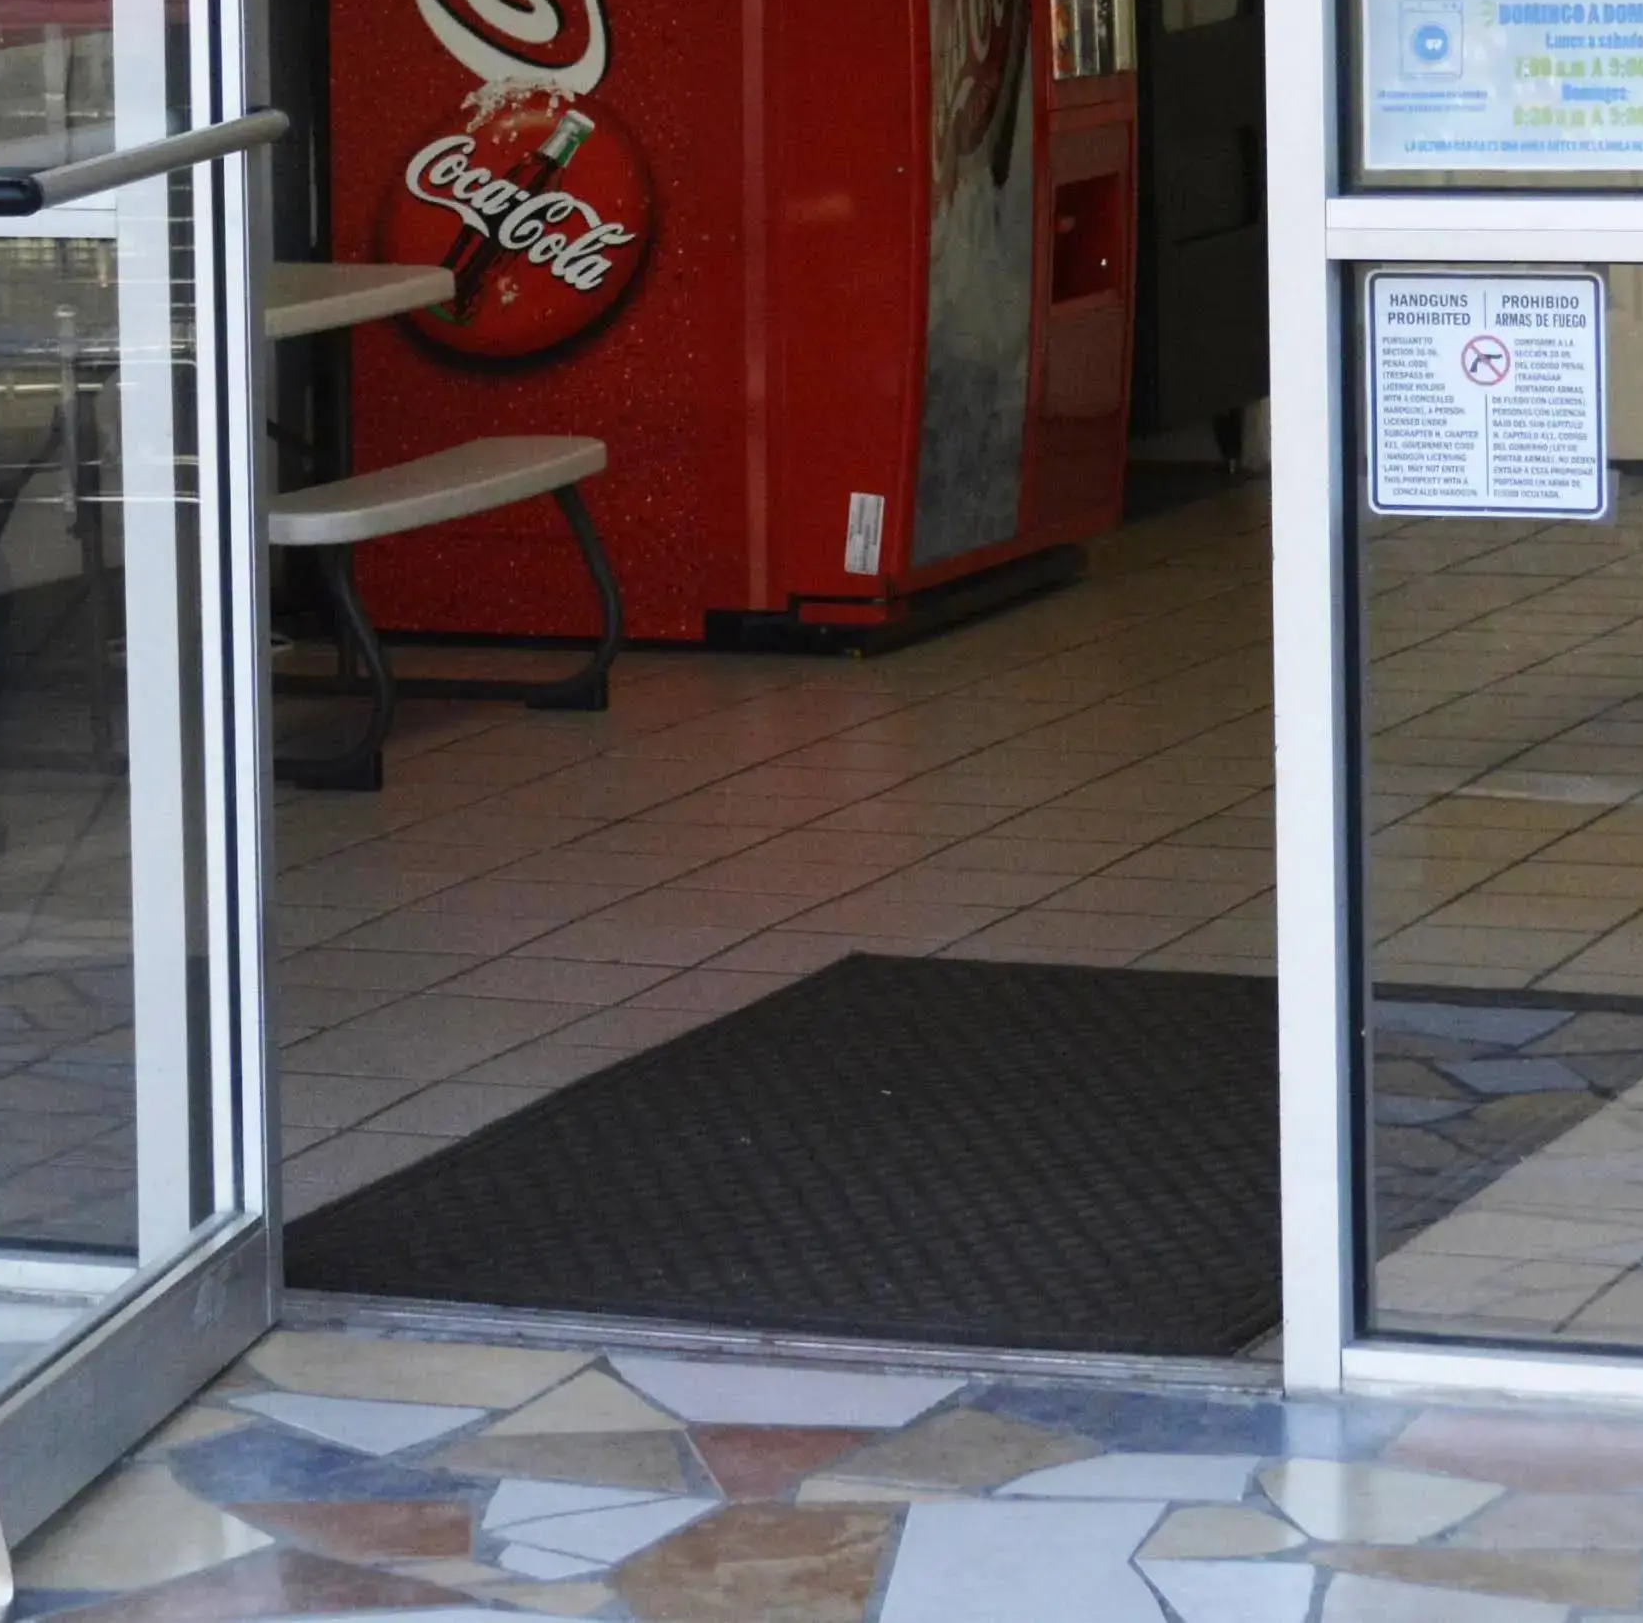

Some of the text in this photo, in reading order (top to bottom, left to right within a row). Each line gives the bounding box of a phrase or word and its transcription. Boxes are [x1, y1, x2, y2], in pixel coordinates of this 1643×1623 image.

[1587, 2, 1601, 26] A
[406, 134, 635, 295] Coca-Cola
[1389, 293, 1469, 308] HANDGUNS
[1501, 295, 1580, 310] PROHIBIDO
[1387, 312, 1471, 326] PROHIBITED
[1495, 313, 1586, 328] ARMAS DE FUEGO
